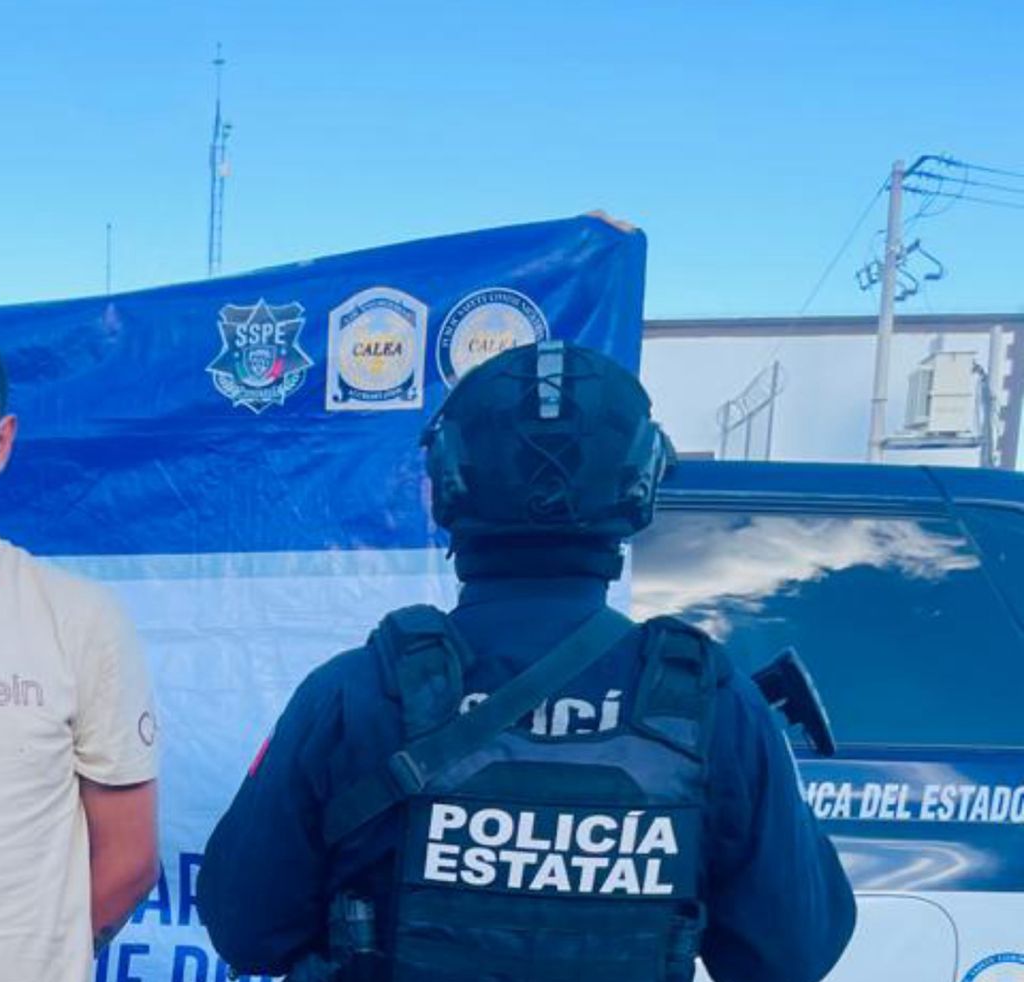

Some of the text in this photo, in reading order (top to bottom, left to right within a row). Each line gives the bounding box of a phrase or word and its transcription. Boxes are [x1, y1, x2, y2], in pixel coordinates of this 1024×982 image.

[235, 322, 286, 347] SSPE
[352, 341, 403, 357] CALEA
[858, 782, 912, 820] DEL
[428, 803, 678, 854] POLICÍA
[424, 842, 674, 895] ESTATAL
